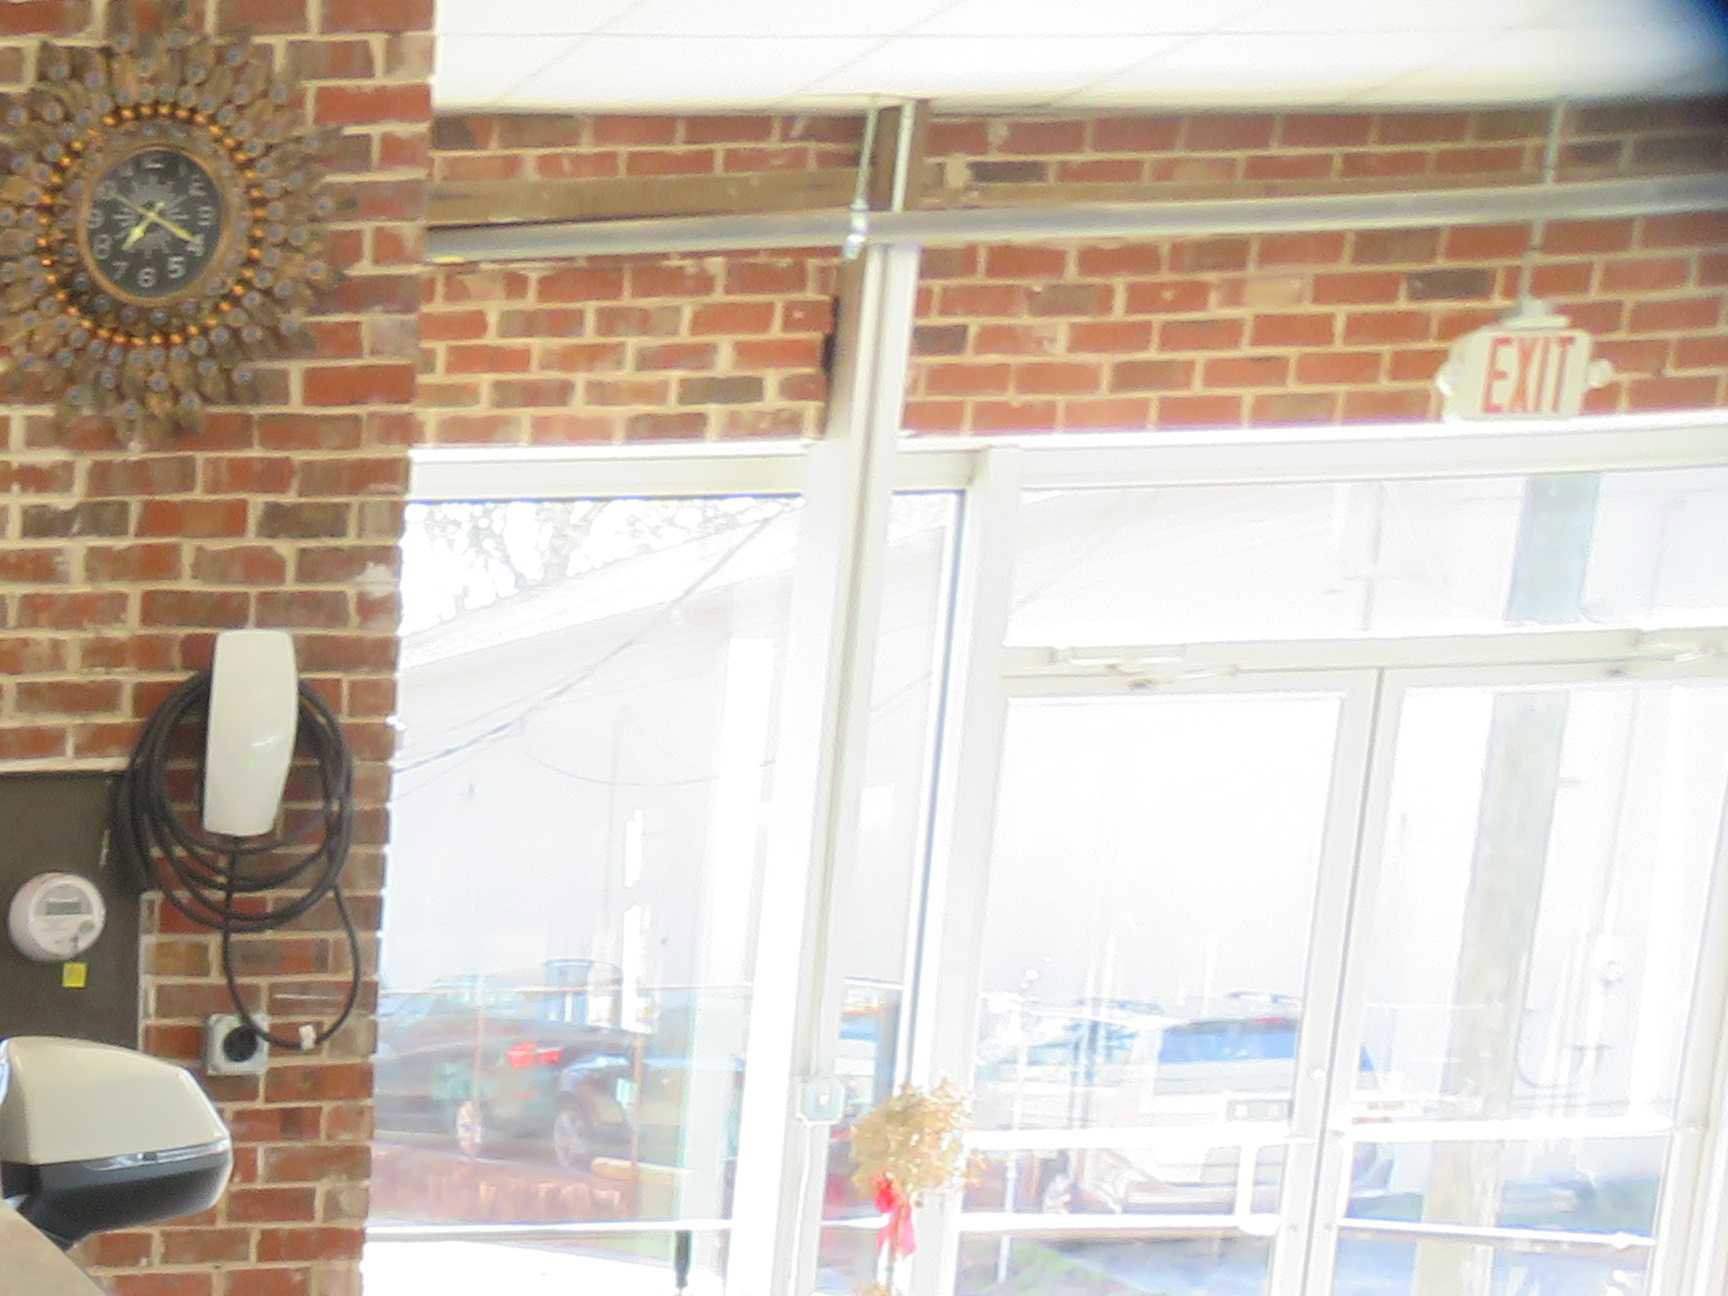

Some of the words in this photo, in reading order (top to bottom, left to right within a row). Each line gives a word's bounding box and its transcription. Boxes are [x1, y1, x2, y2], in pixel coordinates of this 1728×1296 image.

[138, 267, 156, 288] 6
[167, 256, 185, 279] 5
[1481, 335, 1576, 413] EXIT
